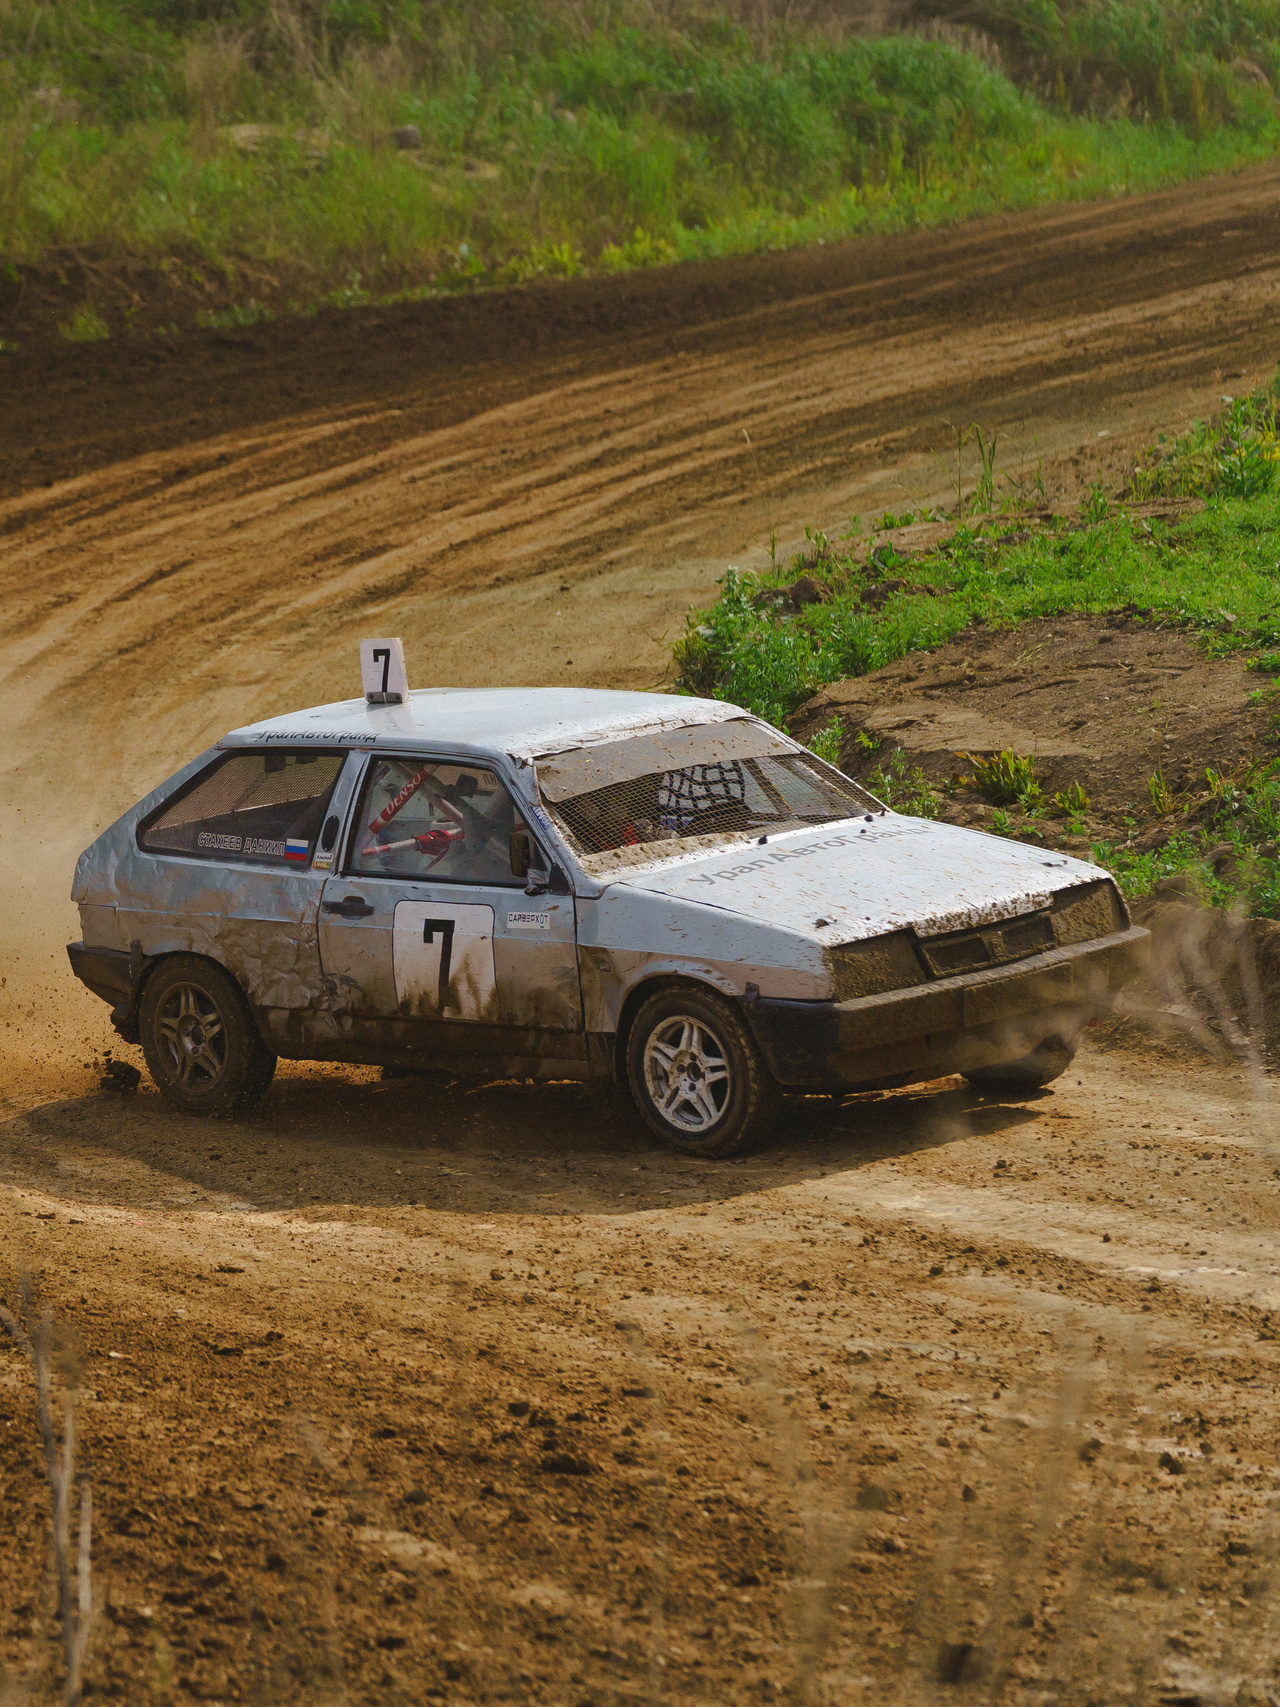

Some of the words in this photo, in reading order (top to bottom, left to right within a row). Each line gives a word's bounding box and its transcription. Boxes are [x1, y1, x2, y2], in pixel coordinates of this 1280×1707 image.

[373, 649, 390, 693] 7
[386, 773, 421, 815] DENSO
[198, 832, 242, 851] СТАХЕЕВ
[243, 837, 286, 856] ДАНИИЛ
[423, 918, 455, 1015] 7
